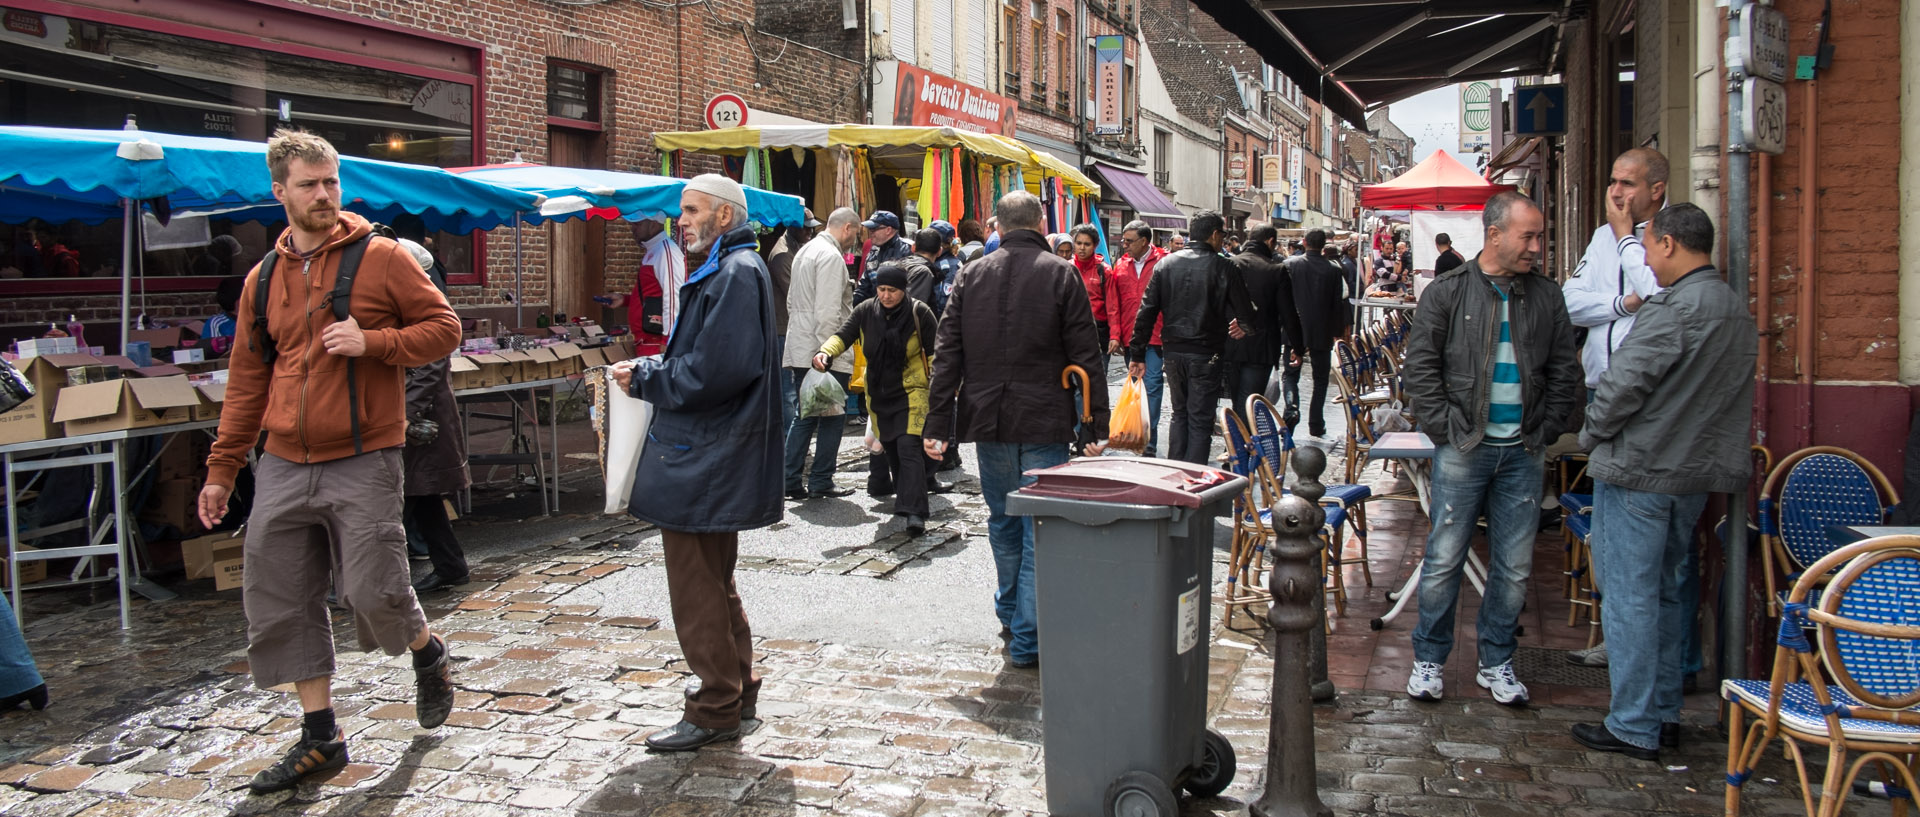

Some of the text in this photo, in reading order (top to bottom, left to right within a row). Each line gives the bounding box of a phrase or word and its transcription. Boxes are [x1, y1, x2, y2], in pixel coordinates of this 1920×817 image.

[920, 75, 1000, 122] Beverly Business
[1105, 65, 1115, 122] L'ARRIVAGE
[929, 112, 955, 127] PRODUITS
